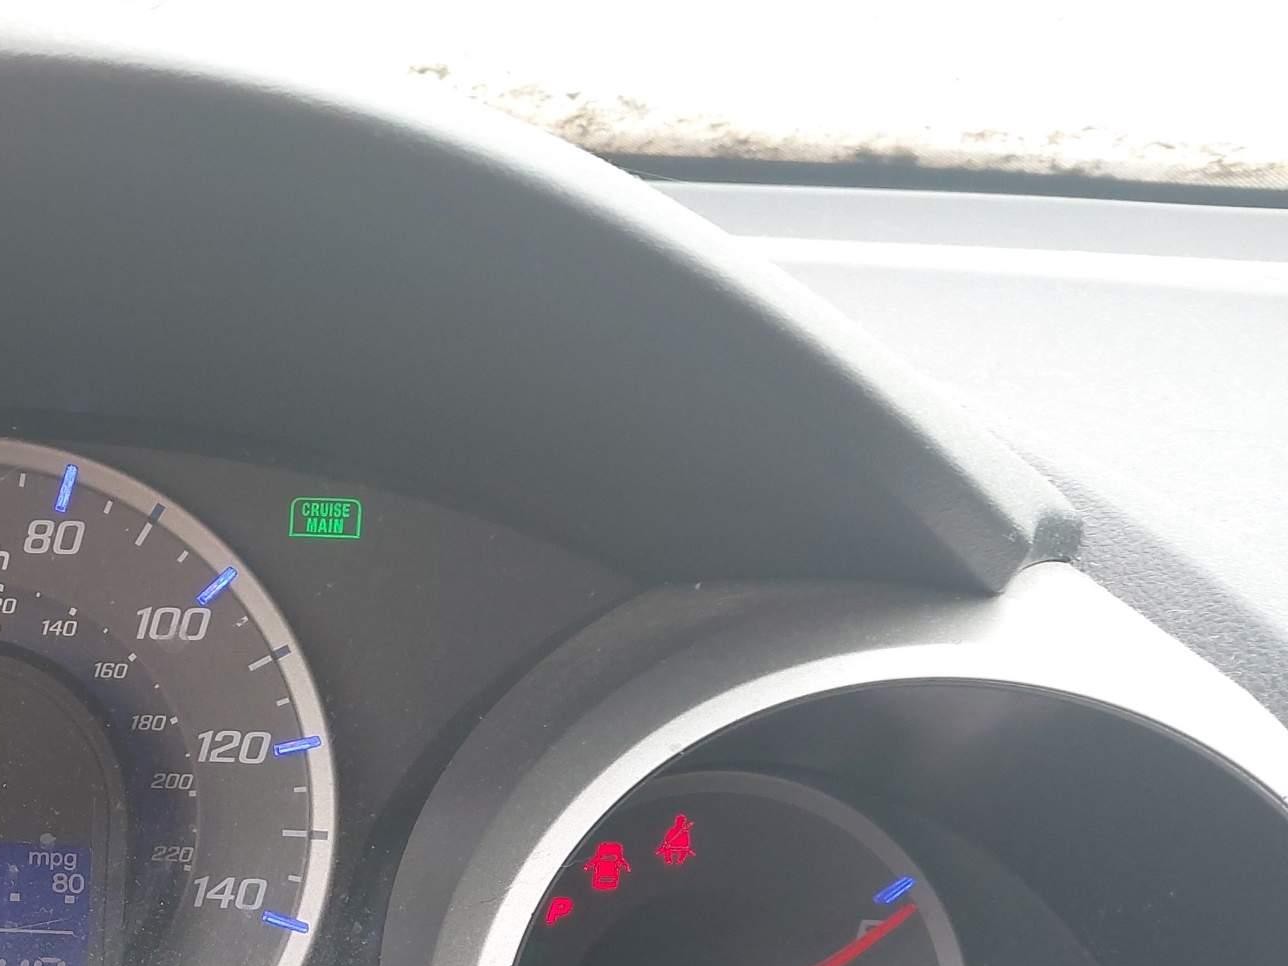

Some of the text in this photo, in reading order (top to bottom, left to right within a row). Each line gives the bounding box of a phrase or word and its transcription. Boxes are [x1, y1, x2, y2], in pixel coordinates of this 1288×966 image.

[302, 502, 351, 518] CRUISE
[306, 518, 344, 533] MAIN
[23, 519, 86, 555] 80
[41, 620, 78, 637] 140
[136, 606, 212, 641] 100
[94, 662, 128, 679] 160
[131, 714, 167, 731] 180
[197, 730, 272, 764] 120
[150, 773, 194, 790] 200
[28, 851, 78, 870] mpg
[151, 846, 194, 862] 220
[52, 873, 85, 894] 80
[194, 875, 268, 910] 140
